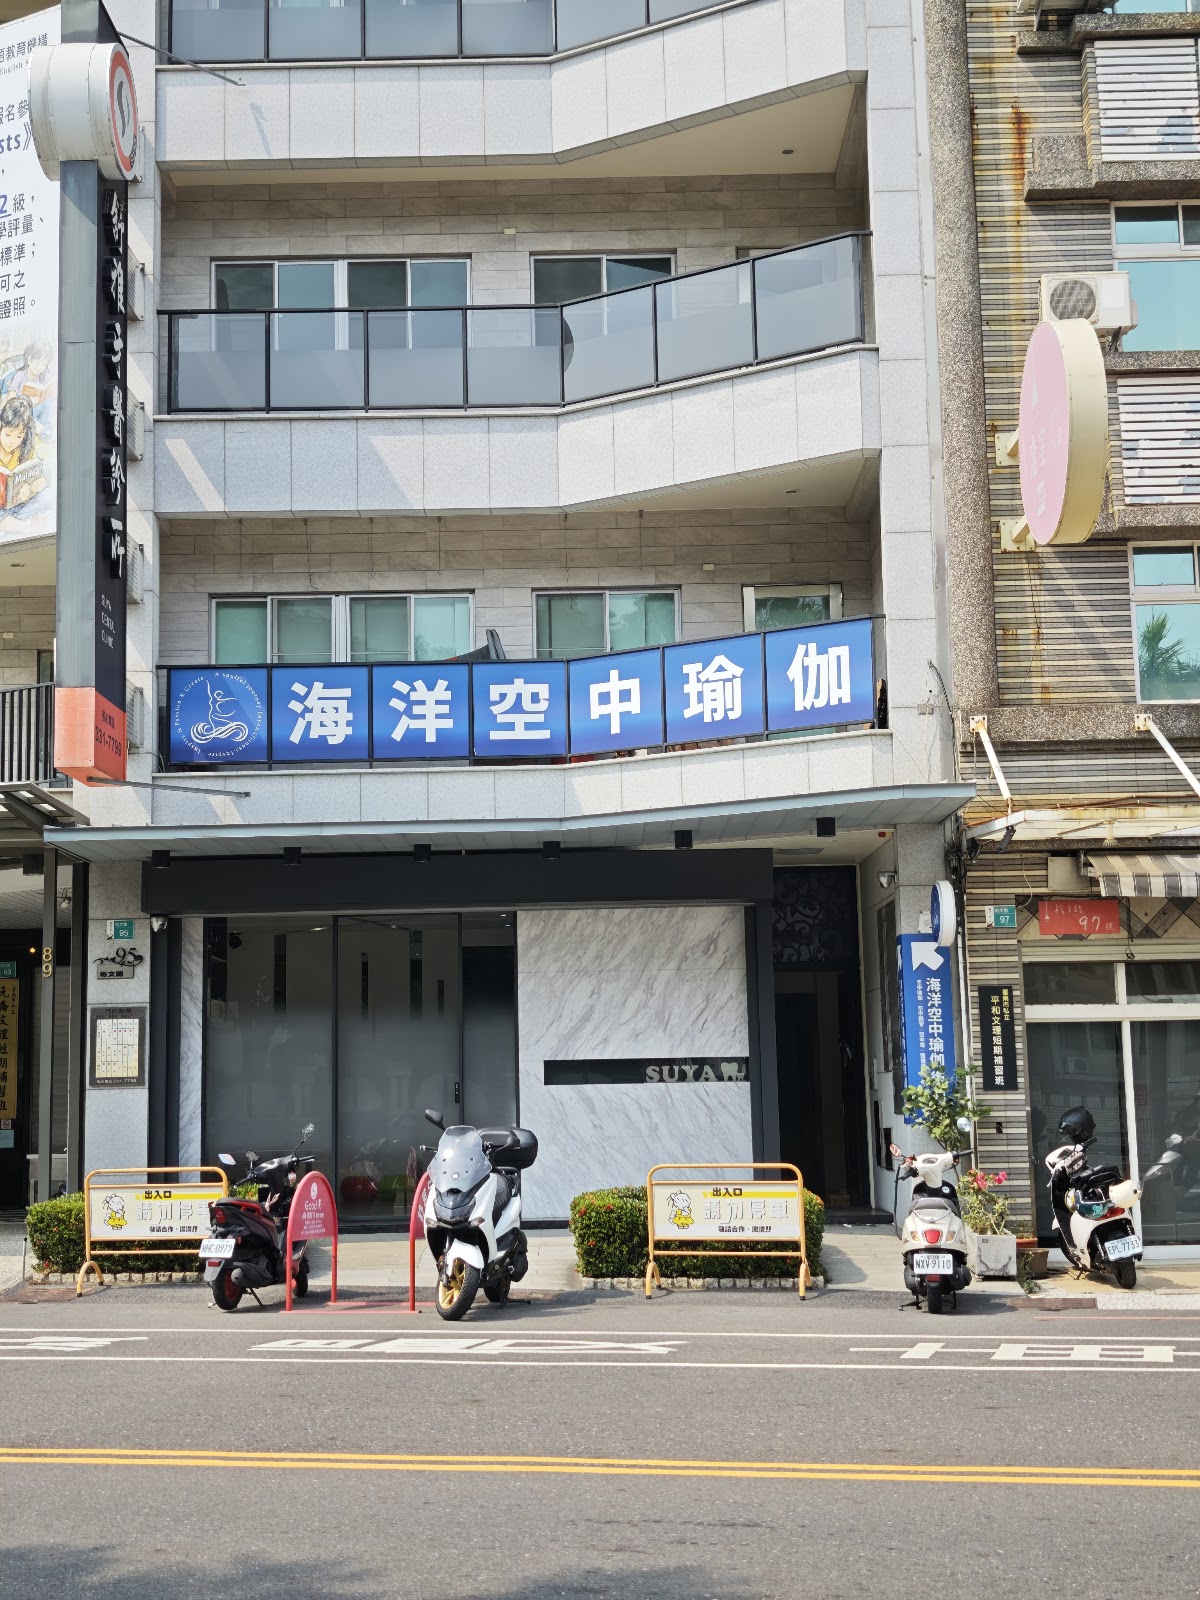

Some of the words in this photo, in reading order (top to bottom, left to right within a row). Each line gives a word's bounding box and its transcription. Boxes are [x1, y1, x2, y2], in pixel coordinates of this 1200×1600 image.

[288, 642, 851, 745] 海洋空中瑜伽
[999, 915, 1010, 925] 97
[115, 947, 138, 965] 95
[990, 995, 1005, 1086] 平和文理短期補習班
[645, 1064, 716, 1084] SUYA
[144, 1189, 172, 1200] 出入口
[712, 1187, 743, 1198] 出入口
[915, 1259, 951, 1269] NXV-9110
